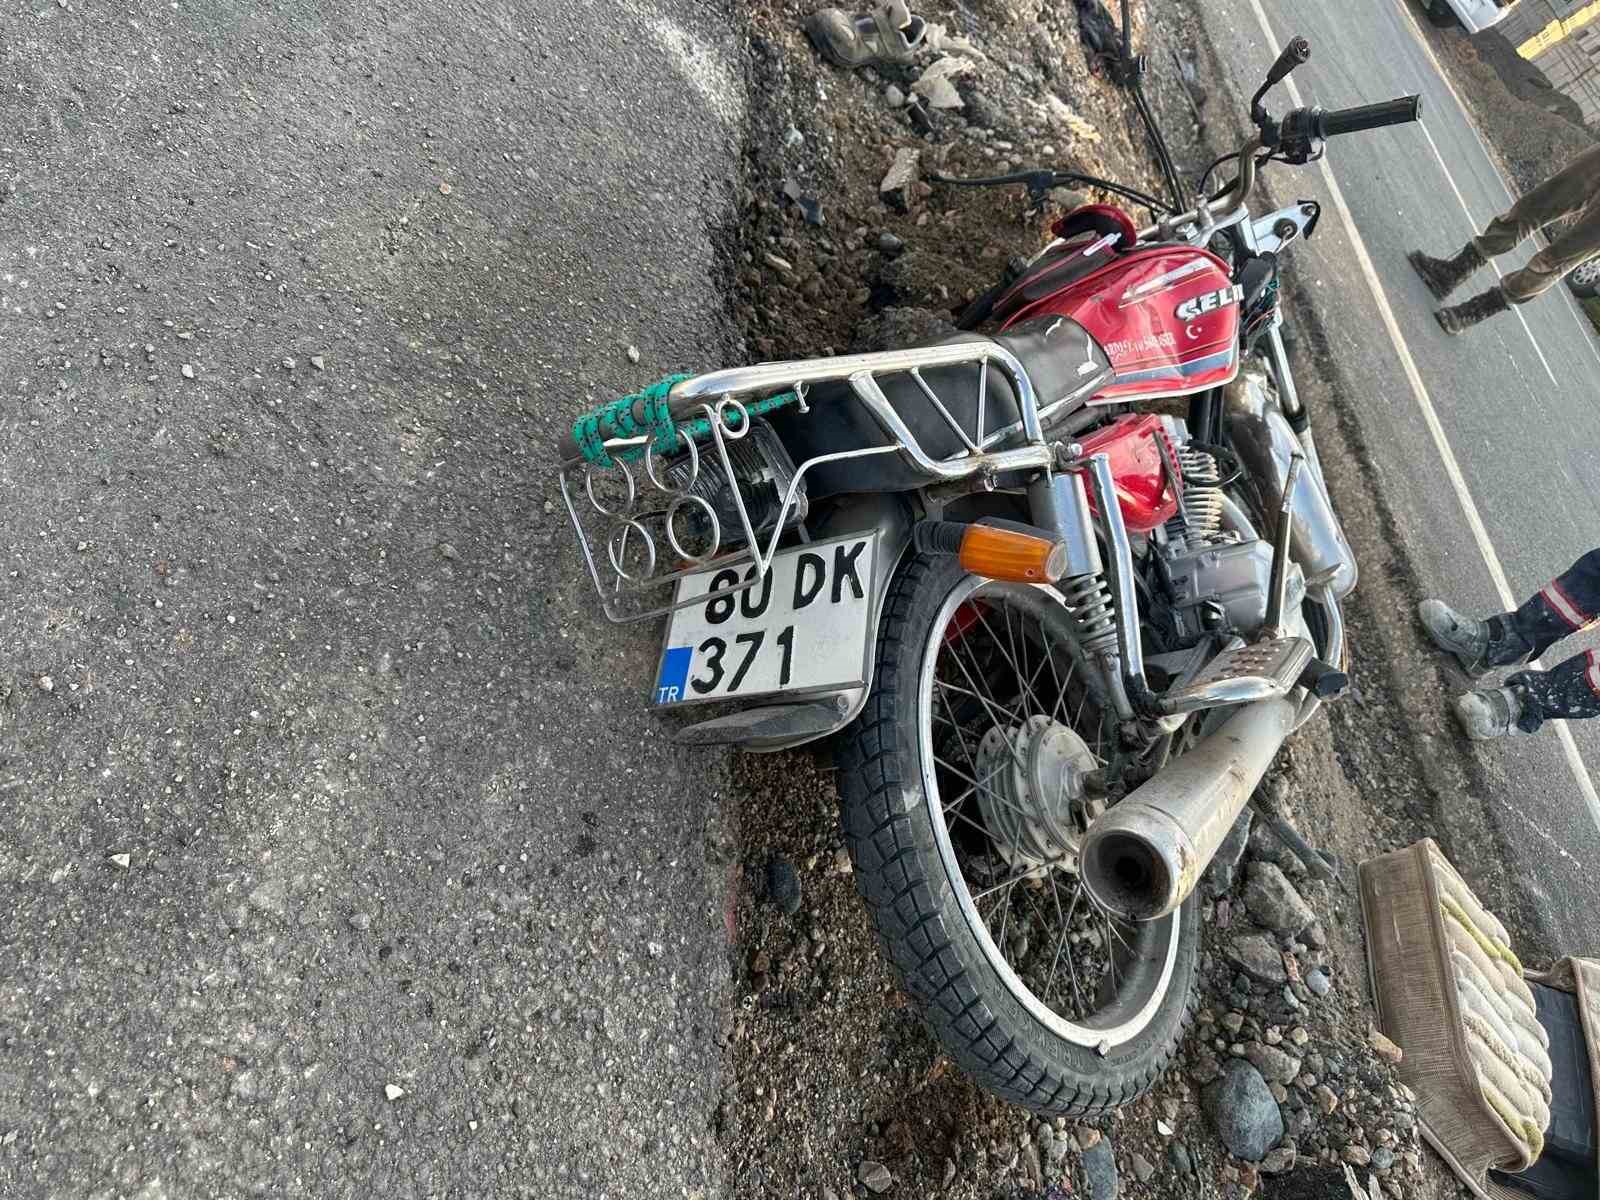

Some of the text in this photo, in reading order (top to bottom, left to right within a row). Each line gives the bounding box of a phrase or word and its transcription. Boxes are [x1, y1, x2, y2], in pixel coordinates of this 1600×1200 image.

[705, 541, 867, 625] 80 DK
[658, 686, 679, 702] TR
[690, 625, 794, 694] 371
